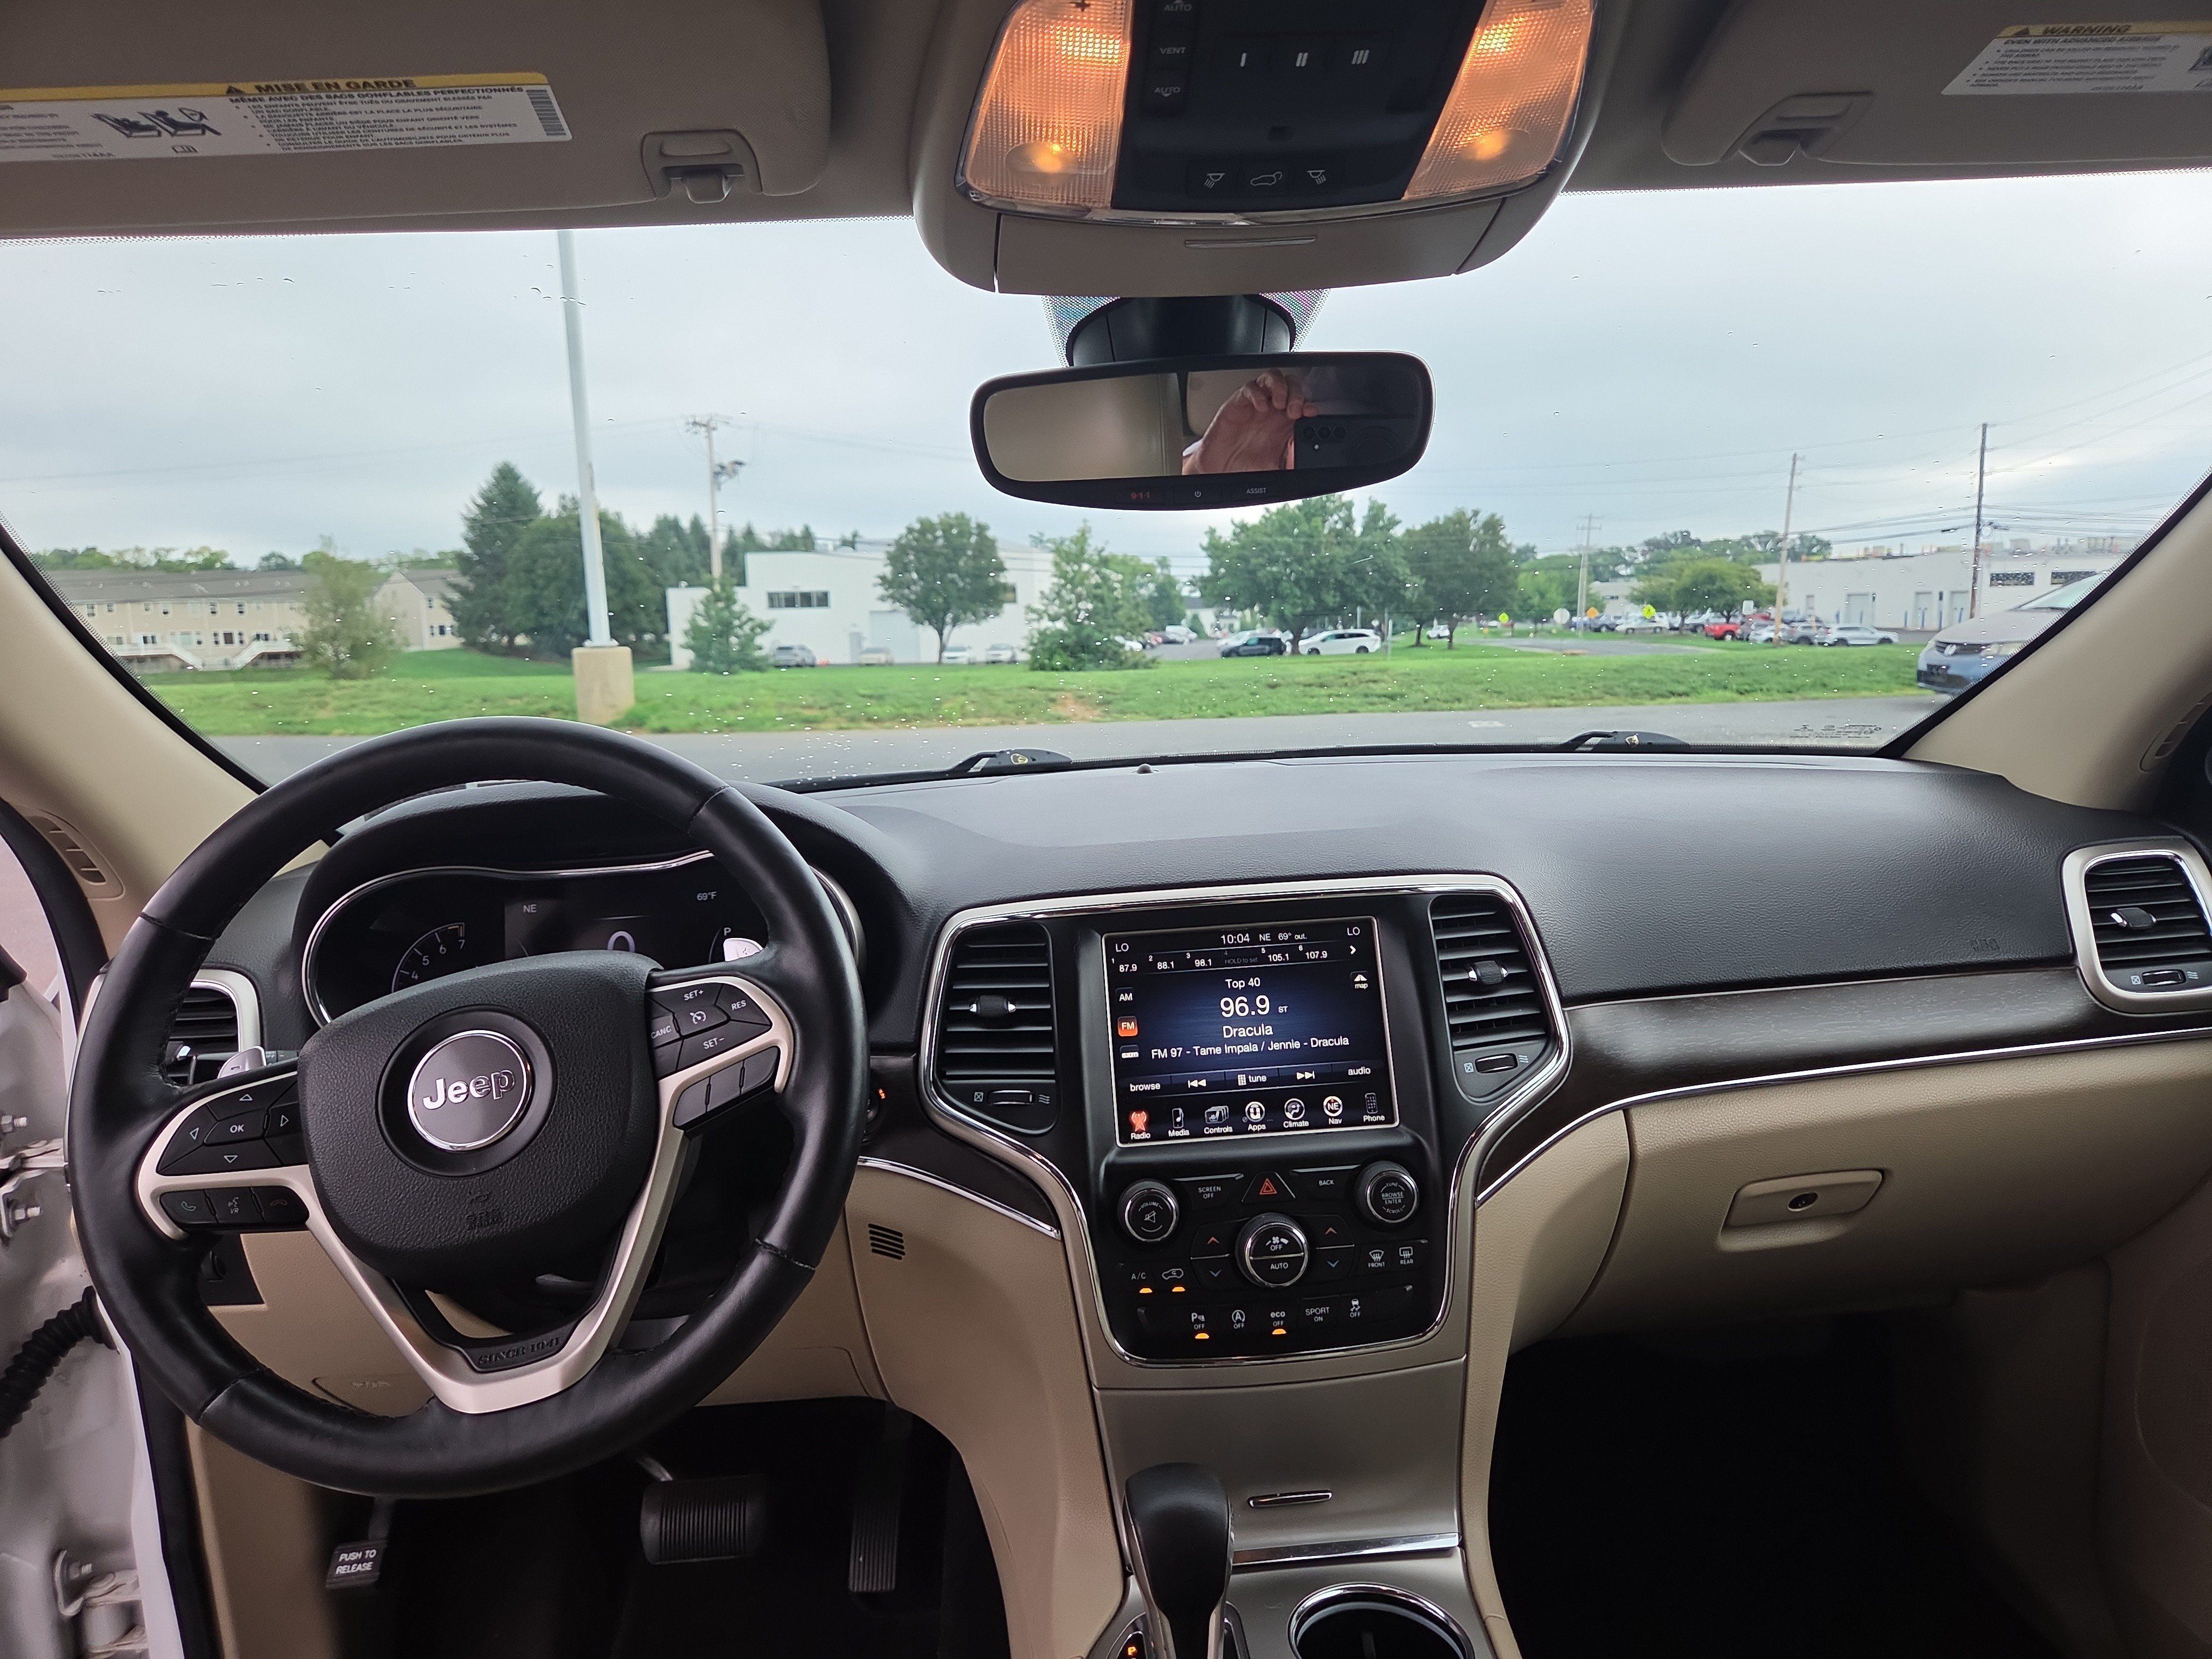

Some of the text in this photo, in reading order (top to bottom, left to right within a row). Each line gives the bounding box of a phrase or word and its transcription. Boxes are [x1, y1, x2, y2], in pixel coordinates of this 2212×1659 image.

[2042, 24, 2132, 35] WARNING
[344, 79, 415, 89] GARDE
[523, 904, 537, 913] NE
[724, 927, 731, 936] P
[1347, 927, 1360, 936] LO
[1220, 933, 1250, 944] 10:04
[1259, 933, 1271, 941] NE
[1278, 932, 1292, 941] 69°
[440, 944, 447, 954] 6
[459, 940, 465, 949] 7
[1115, 943, 1129, 953] LO
[1268, 953, 1289, 962] 105.1
[1305, 950, 1328, 960] 107.9
[422, 955, 429, 966] 5
[1194, 958, 1212, 967] 98.1
[1119, 963, 1137, 973] 87.9
[1157, 961, 1174, 970] 88.1
[411, 971, 418, 980] 4
[1225, 977, 1261, 991] Top 40
[1119, 993, 1133, 1002] AM
[731, 1000, 747, 1011] RES
[1220, 995, 1270, 1018] 96.9
[1121, 1021, 1135, 1031] FM
[1223, 1023, 1274, 1038] Dracula
[1151, 1048, 1168, 1059] FM
[1170, 1047, 1183, 1057] 97
[1193, 1046, 1221, 1056] Tame
[1225, 1041, 1258, 1055] Impala
[1261, 1041, 1265, 1051] /
[1268, 1039, 1301, 1051] Jennie
[1310, 1035, 1349, 1047] Dracula
[1348, 1066, 1371, 1076] audio
[1249, 1074, 1267, 1083] tune
[423, 1069, 516, 1110] Jeep
[1129, 1083, 1161, 1092] browse
[1327, 1103, 1340, 1111] NE
[1363, 1114, 1385, 1122] Phone
[230, 1124, 245, 1133] OK
[1248, 1123, 1266, 1132] Apps
[1283, 1120, 1309, 1128] Climate
[1168, 1129, 1189, 1137] Media
[1204, 1126, 1233, 1134] Controls
[1130, 1132, 1151, 1140] Radio
[1305, 1307, 1329, 1316] SPORT
[339, 1549, 377, 1562] PUSH TO
[336, 1561, 374, 1574] RELEASE
